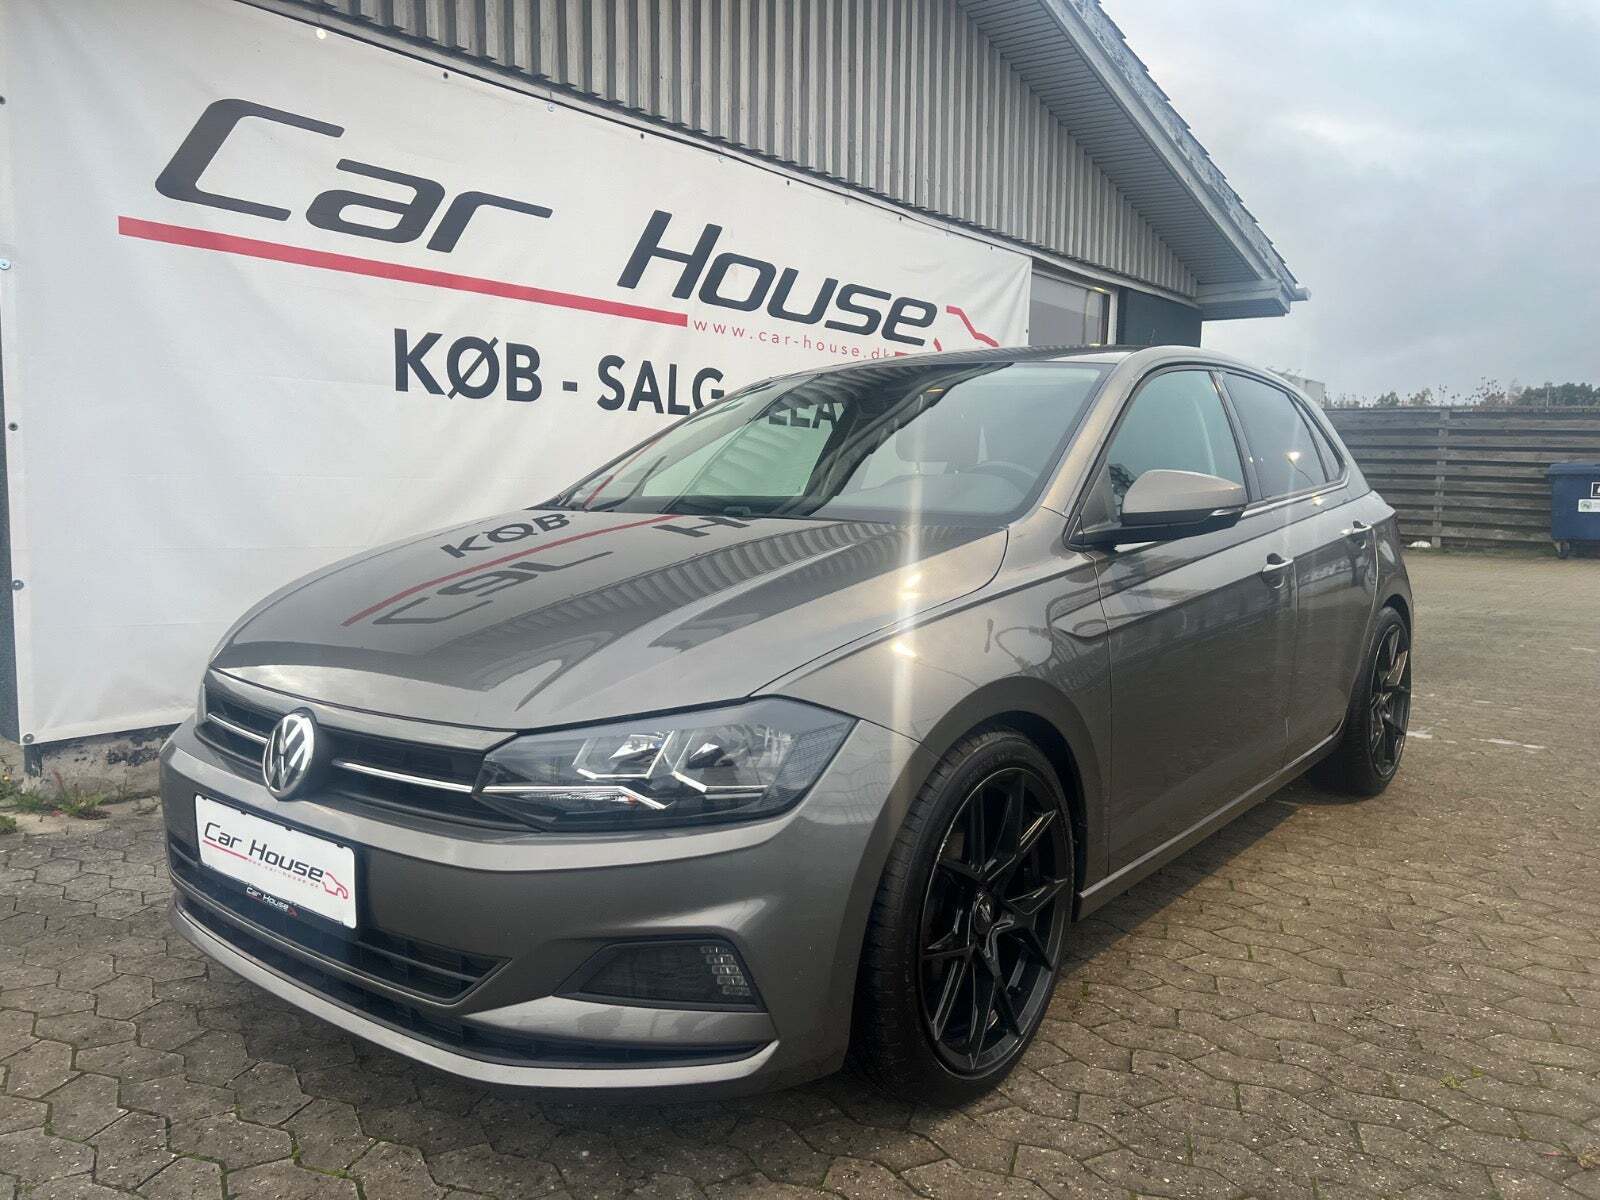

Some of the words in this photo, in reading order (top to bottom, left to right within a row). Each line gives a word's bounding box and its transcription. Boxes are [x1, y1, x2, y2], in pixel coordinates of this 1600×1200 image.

[155, 98, 552, 253] Car
[617, 210, 938, 346] House
[394, 328, 542, 402] KØB
[597, 354, 725, 416] SALG
[204, 822, 242, 848] Car
[249, 839, 324, 883] House
